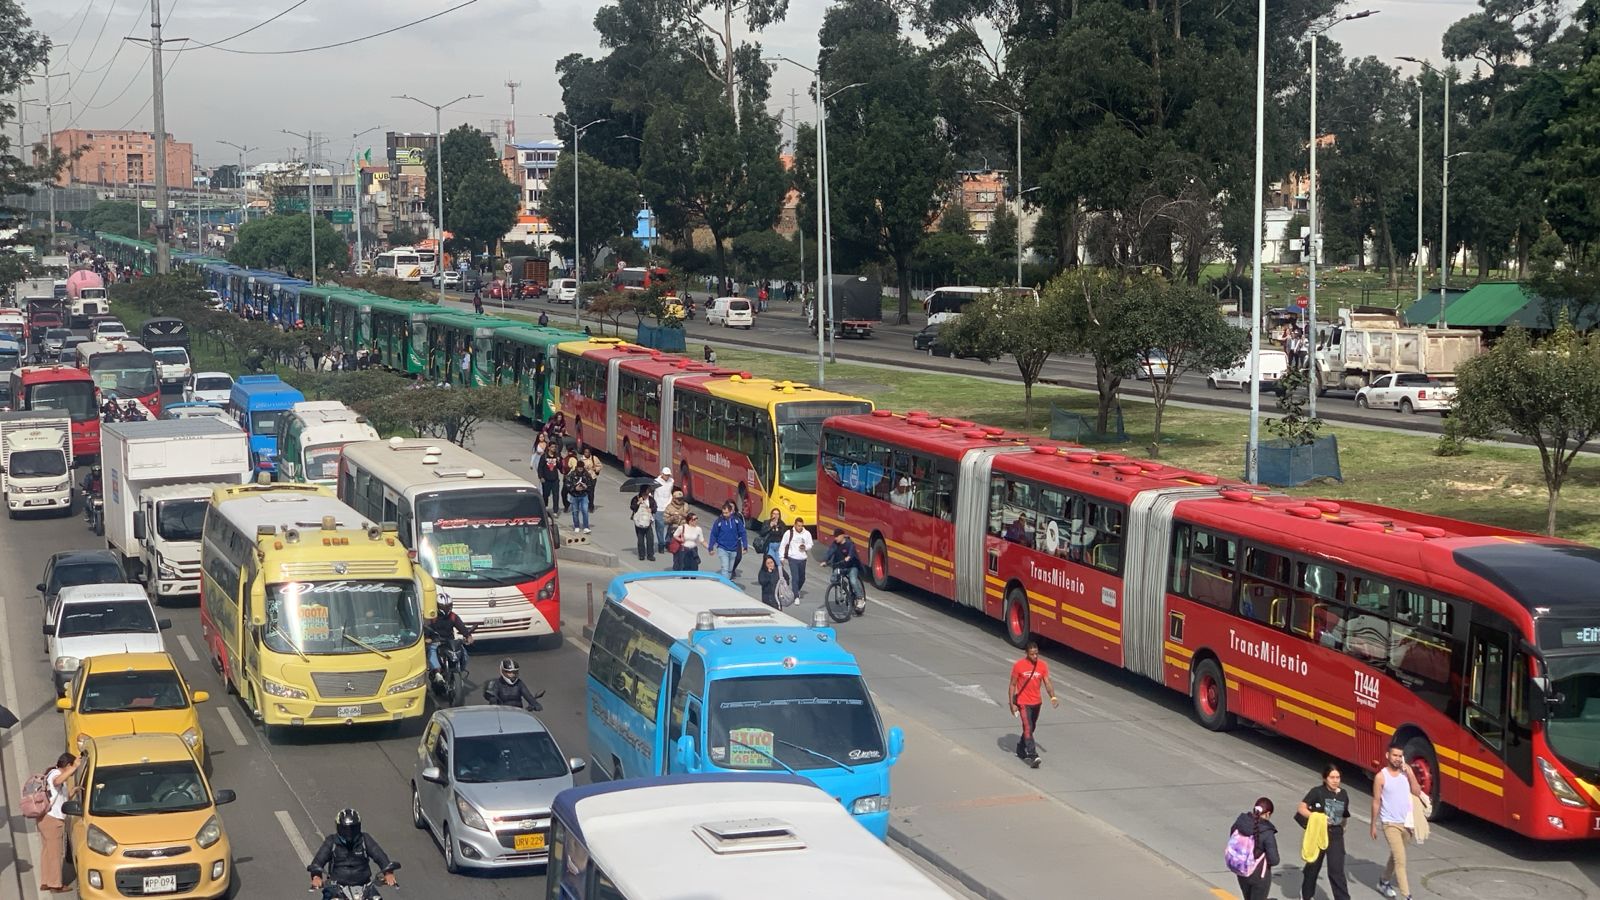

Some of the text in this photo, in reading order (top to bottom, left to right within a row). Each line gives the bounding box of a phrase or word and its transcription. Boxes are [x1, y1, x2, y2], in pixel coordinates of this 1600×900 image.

[706, 449, 731, 469] TransMilenio
[1030, 561, 1085, 595] TransMilenio
[297, 607, 328, 618] OGOTA
[1229, 629, 1308, 676] TransMilenio
[1354, 669, 1380, 699] T1444
